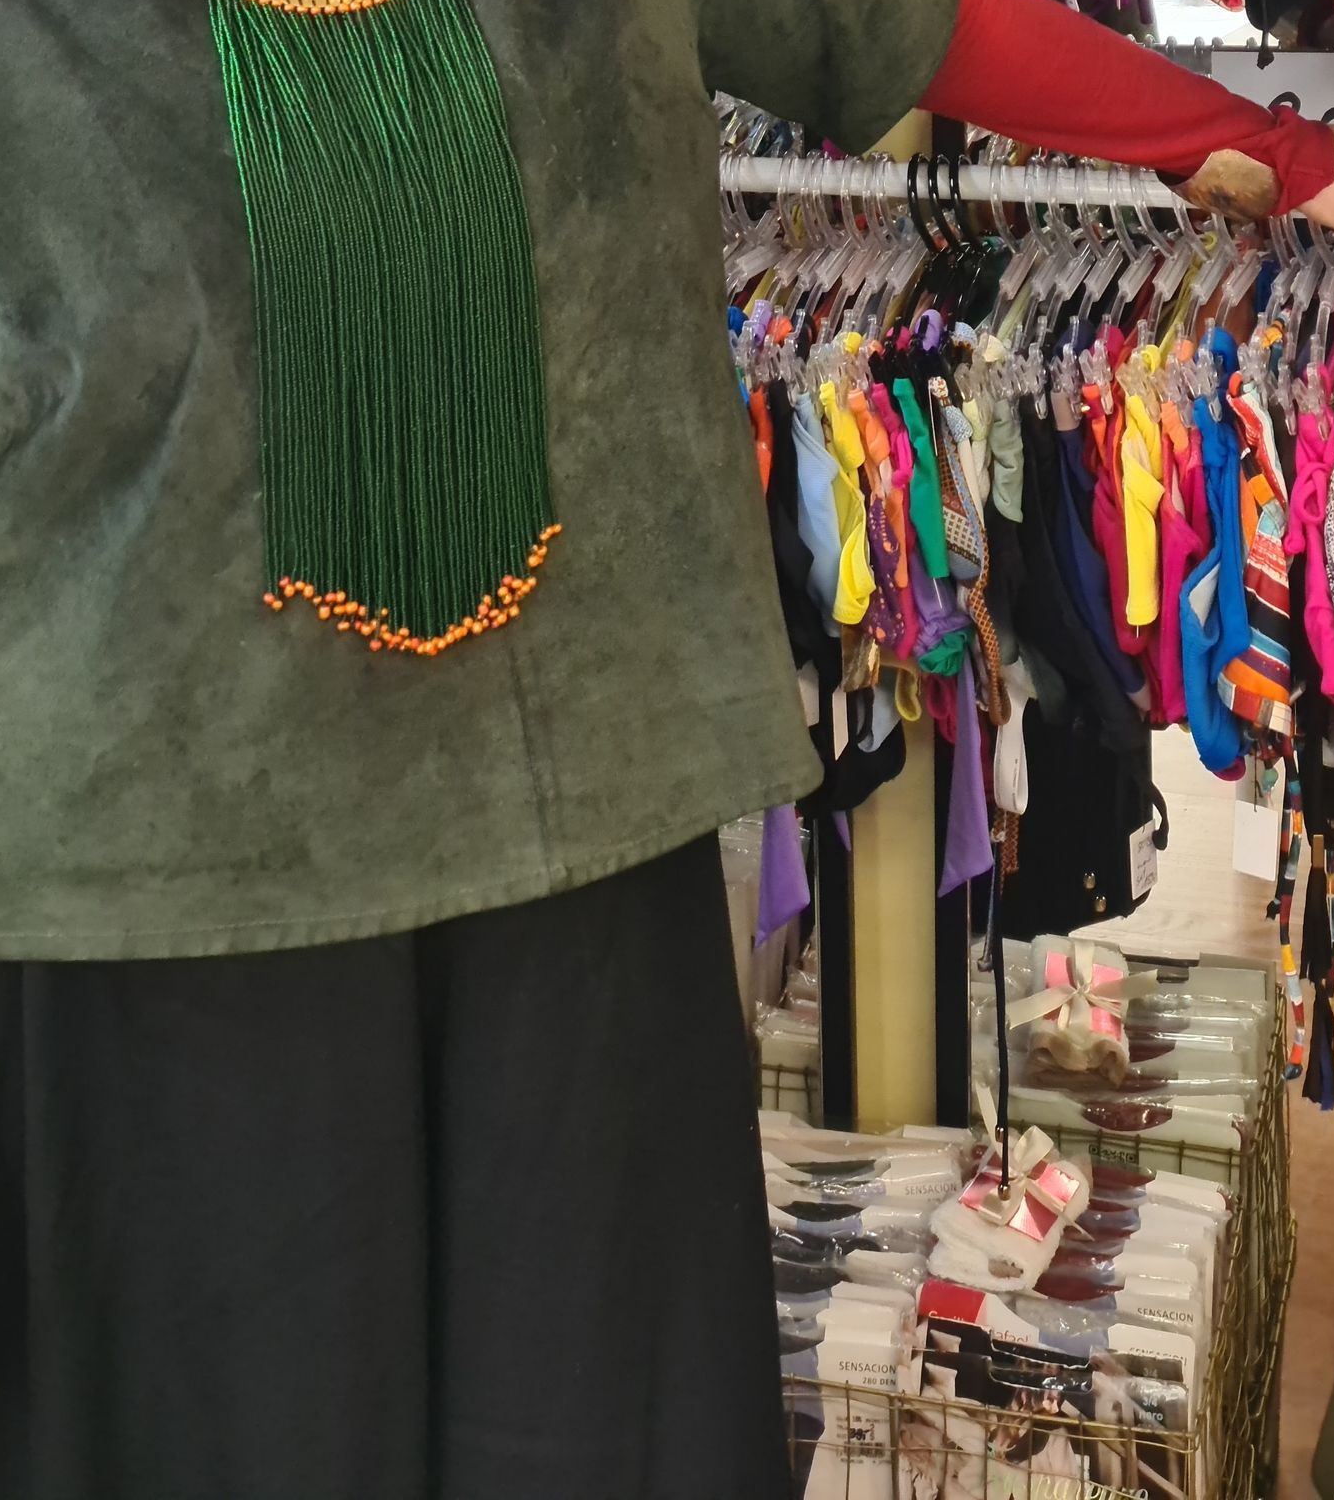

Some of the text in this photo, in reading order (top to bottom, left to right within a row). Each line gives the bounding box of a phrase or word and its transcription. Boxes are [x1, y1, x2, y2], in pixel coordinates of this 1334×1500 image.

[904, 1183, 957, 1196] SENSACION
[1137, 1307, 1194, 1323] SENSACION
[838, 1360, 897, 1374] SENSACION
[879, 1377, 897, 1386] DEN
[1138, 1411, 1164, 1421] nero
